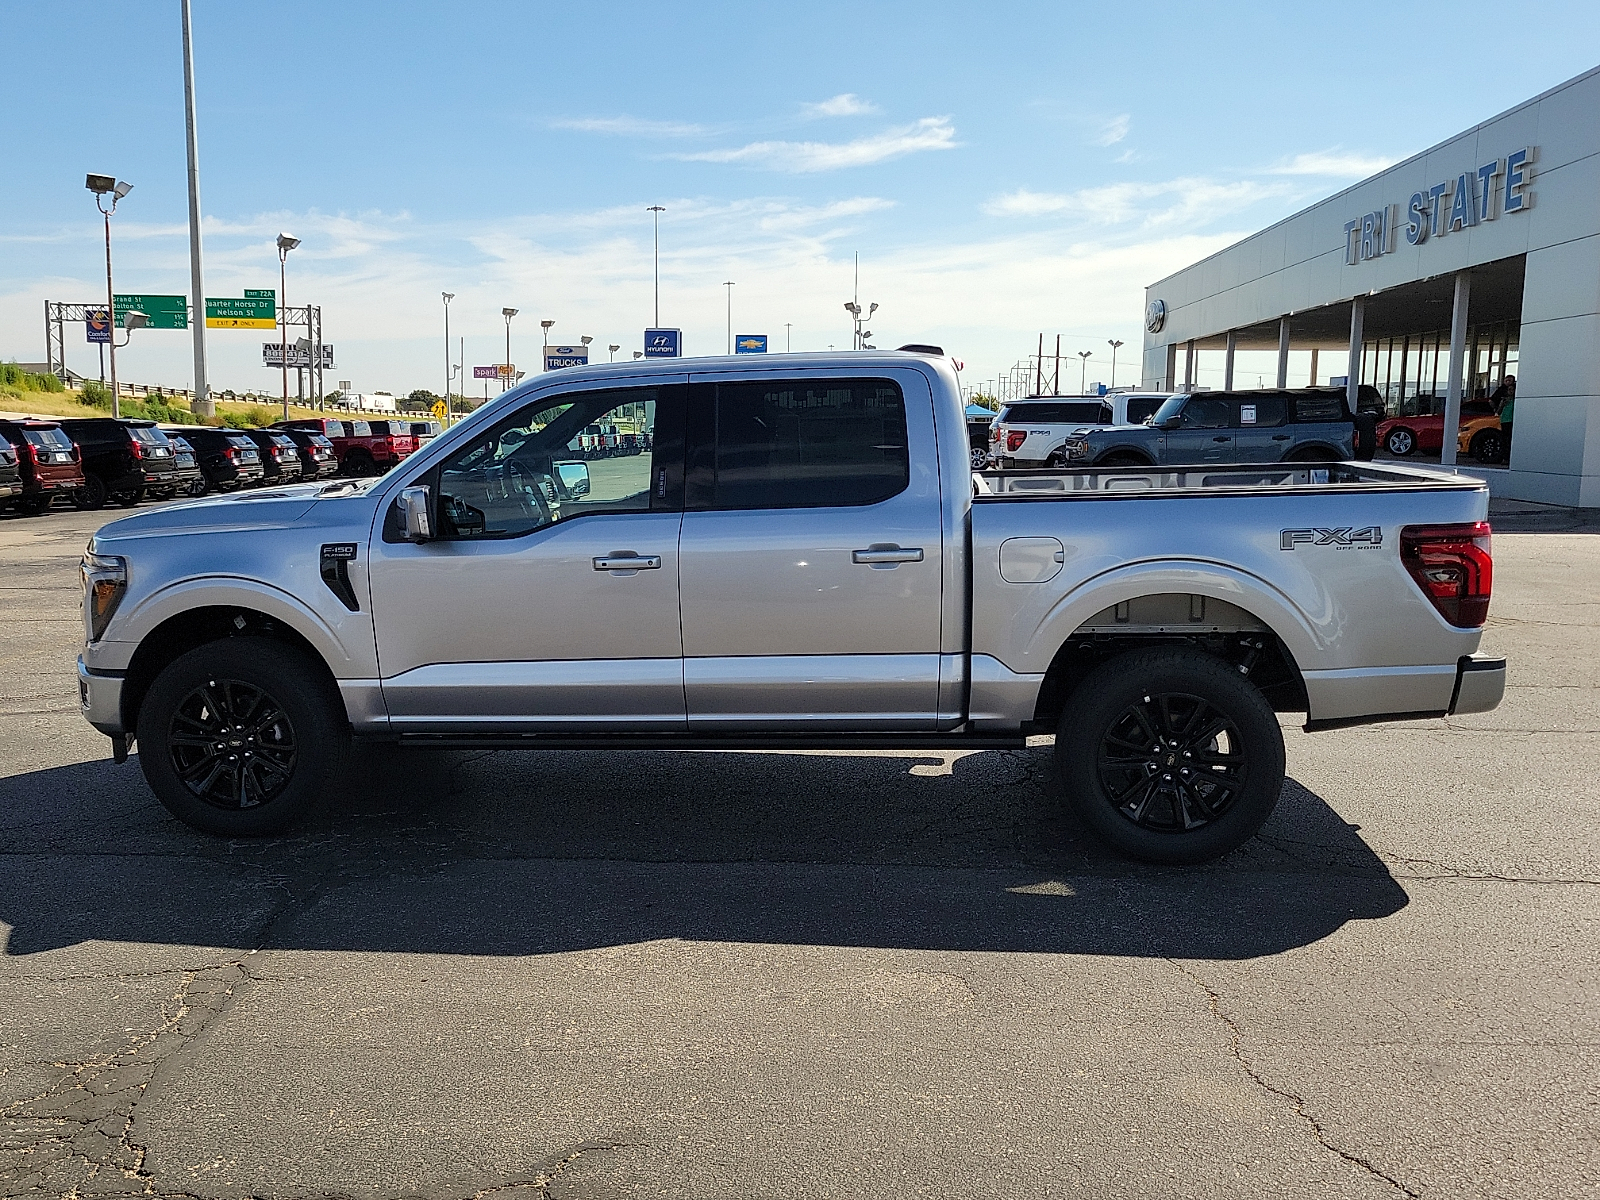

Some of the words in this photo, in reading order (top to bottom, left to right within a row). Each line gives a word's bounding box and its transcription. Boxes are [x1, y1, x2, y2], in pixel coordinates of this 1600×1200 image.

[1343, 204, 1396, 266] TRI
[1405, 146, 1537, 246] STATE
[548, 358, 583, 367] TRUCKS
[476, 367, 496, 377] spark
[1280, 526, 1383, 551] FX4
